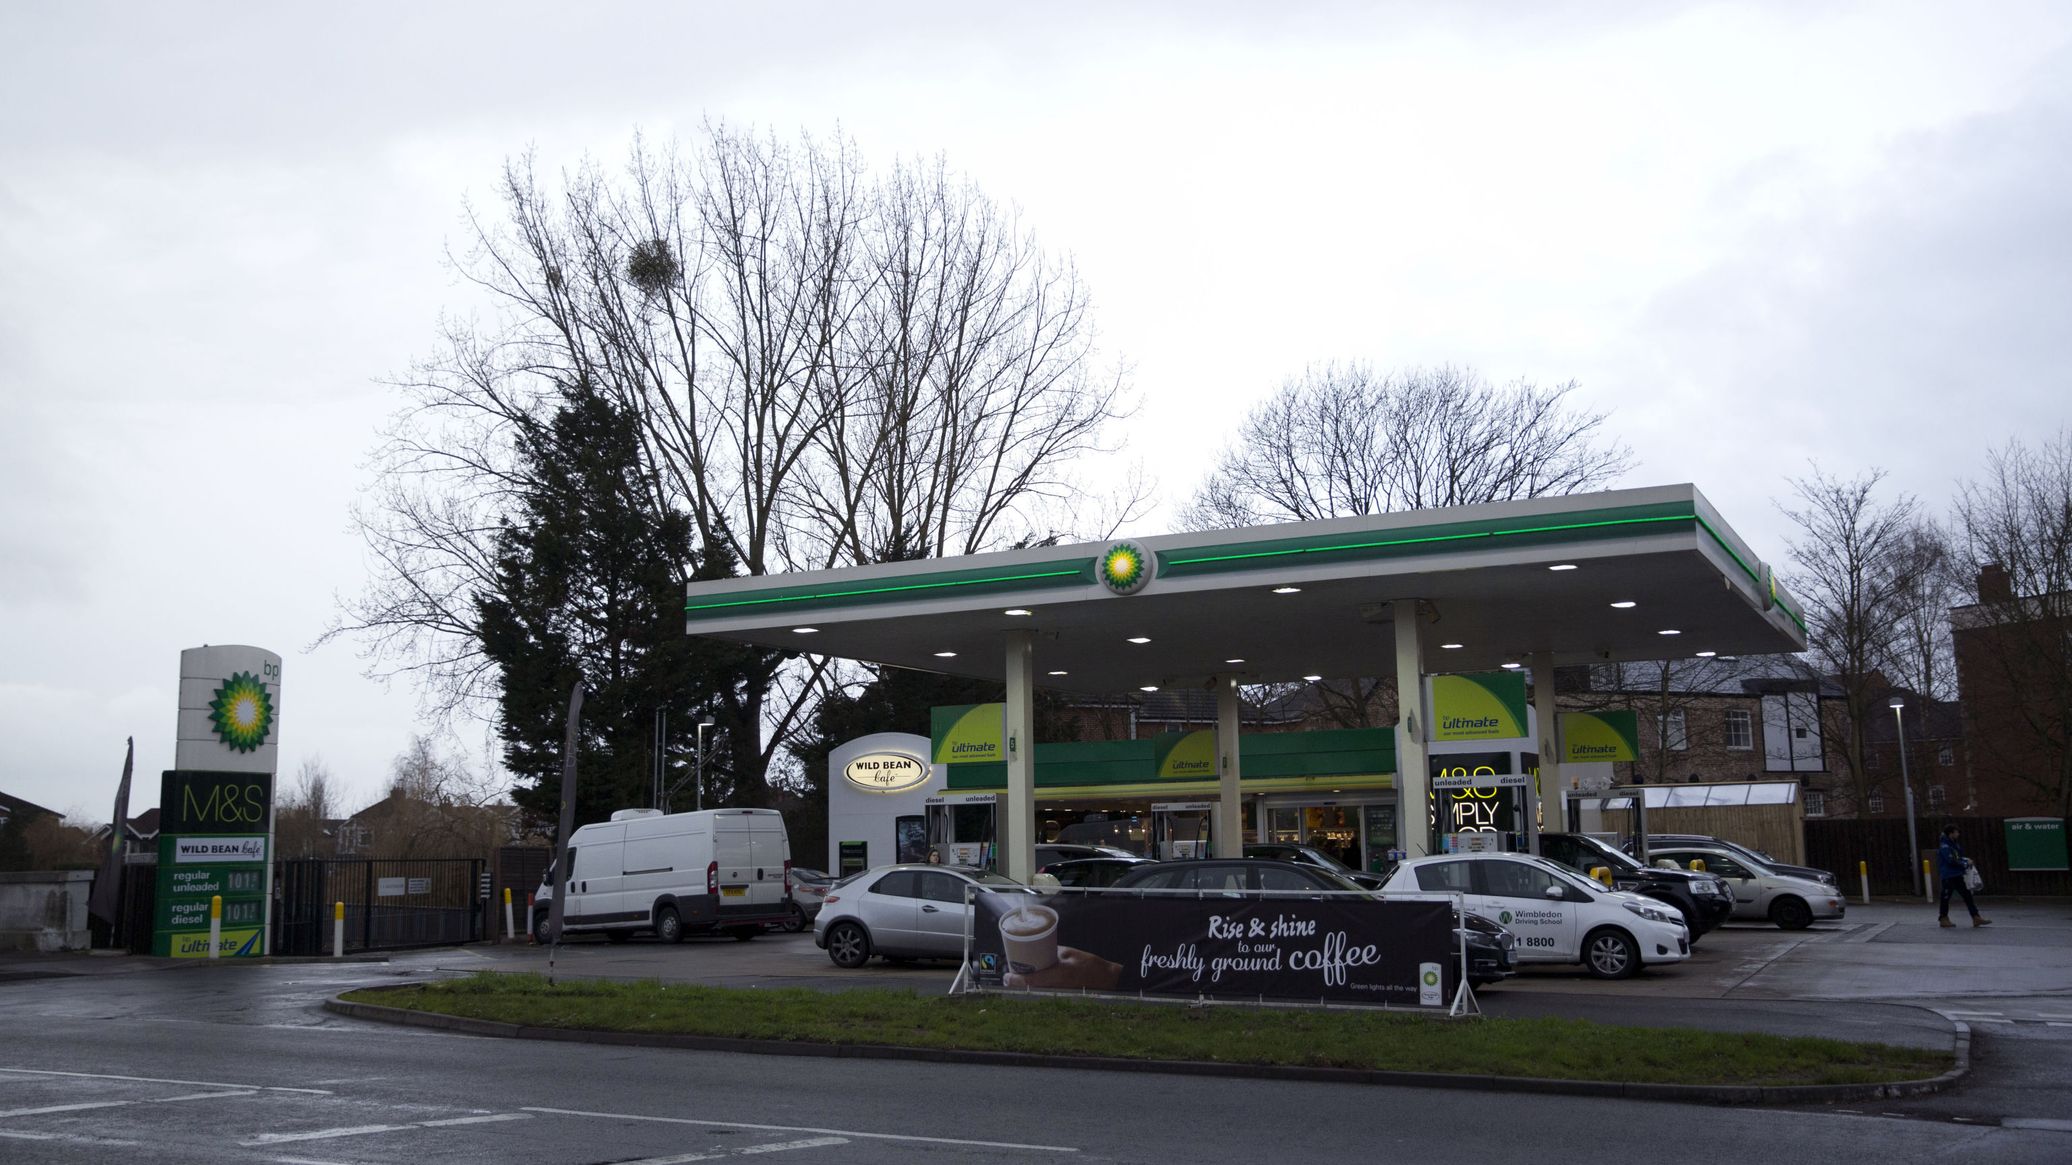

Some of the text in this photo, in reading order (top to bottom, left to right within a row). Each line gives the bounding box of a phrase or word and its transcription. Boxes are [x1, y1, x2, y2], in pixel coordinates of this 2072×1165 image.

[264, 659, 279, 681] bp
[1443, 716, 1498, 729] ultimate
[952, 741, 996, 753] ultimate
[1572, 744, 1617, 754] ultimate
[856, 761, 911, 770] WILD BEAN
[1172, 759, 1209, 769] ultimate
[1434, 778, 1472, 786] unleaded
[1500, 776, 1525, 784] diesel
[182, 784, 263, 823] M&S
[181, 845, 209, 854] WILD
[211, 845, 239, 854] BEAN
[173, 870, 211, 882] regular
[173, 881, 220, 892] unleaded
[171, 902, 209, 914] regular
[171, 914, 204, 925] diesel
[1515, 910, 1562, 918] Wimbledon
[1208, 914, 1316, 939] Rise & shine
[1237, 940, 1276, 953] to our
[1526, 937, 1555, 947] 8800
[1140, 931, 1382, 987] freshly ground coffee
[1350, 982, 1368, 990] Green
[1369, 983, 1385, 991] lights
